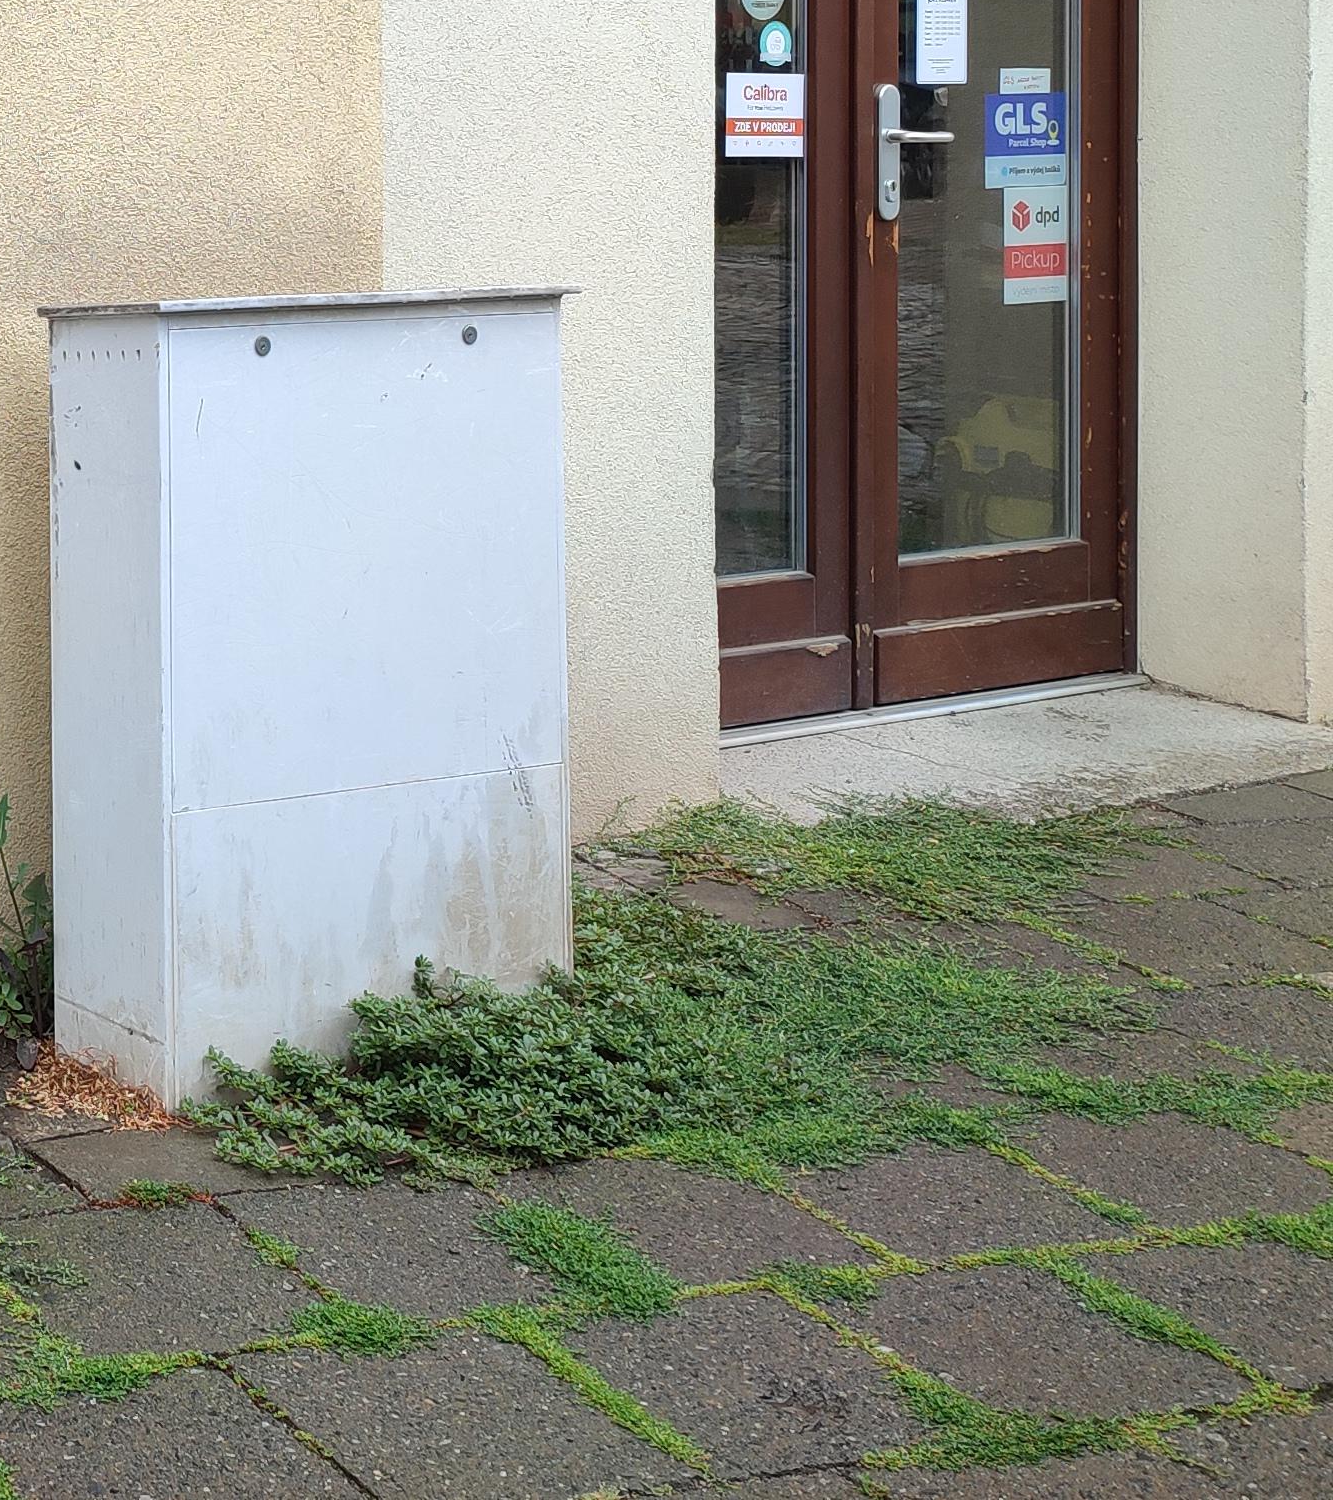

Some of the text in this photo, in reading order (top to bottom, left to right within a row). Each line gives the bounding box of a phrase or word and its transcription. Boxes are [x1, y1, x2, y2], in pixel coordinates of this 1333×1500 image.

[743, 84, 788, 101] Calibra
[734, 121, 752, 133] ZDE
[753, 121, 760, 132] V
[995, 102, 1048, 135] GLS
[1008, 137, 1047, 148] Parcel Shop
[1035, 205, 1060, 228] dpd
[1011, 250, 1061, 272] Pickup
